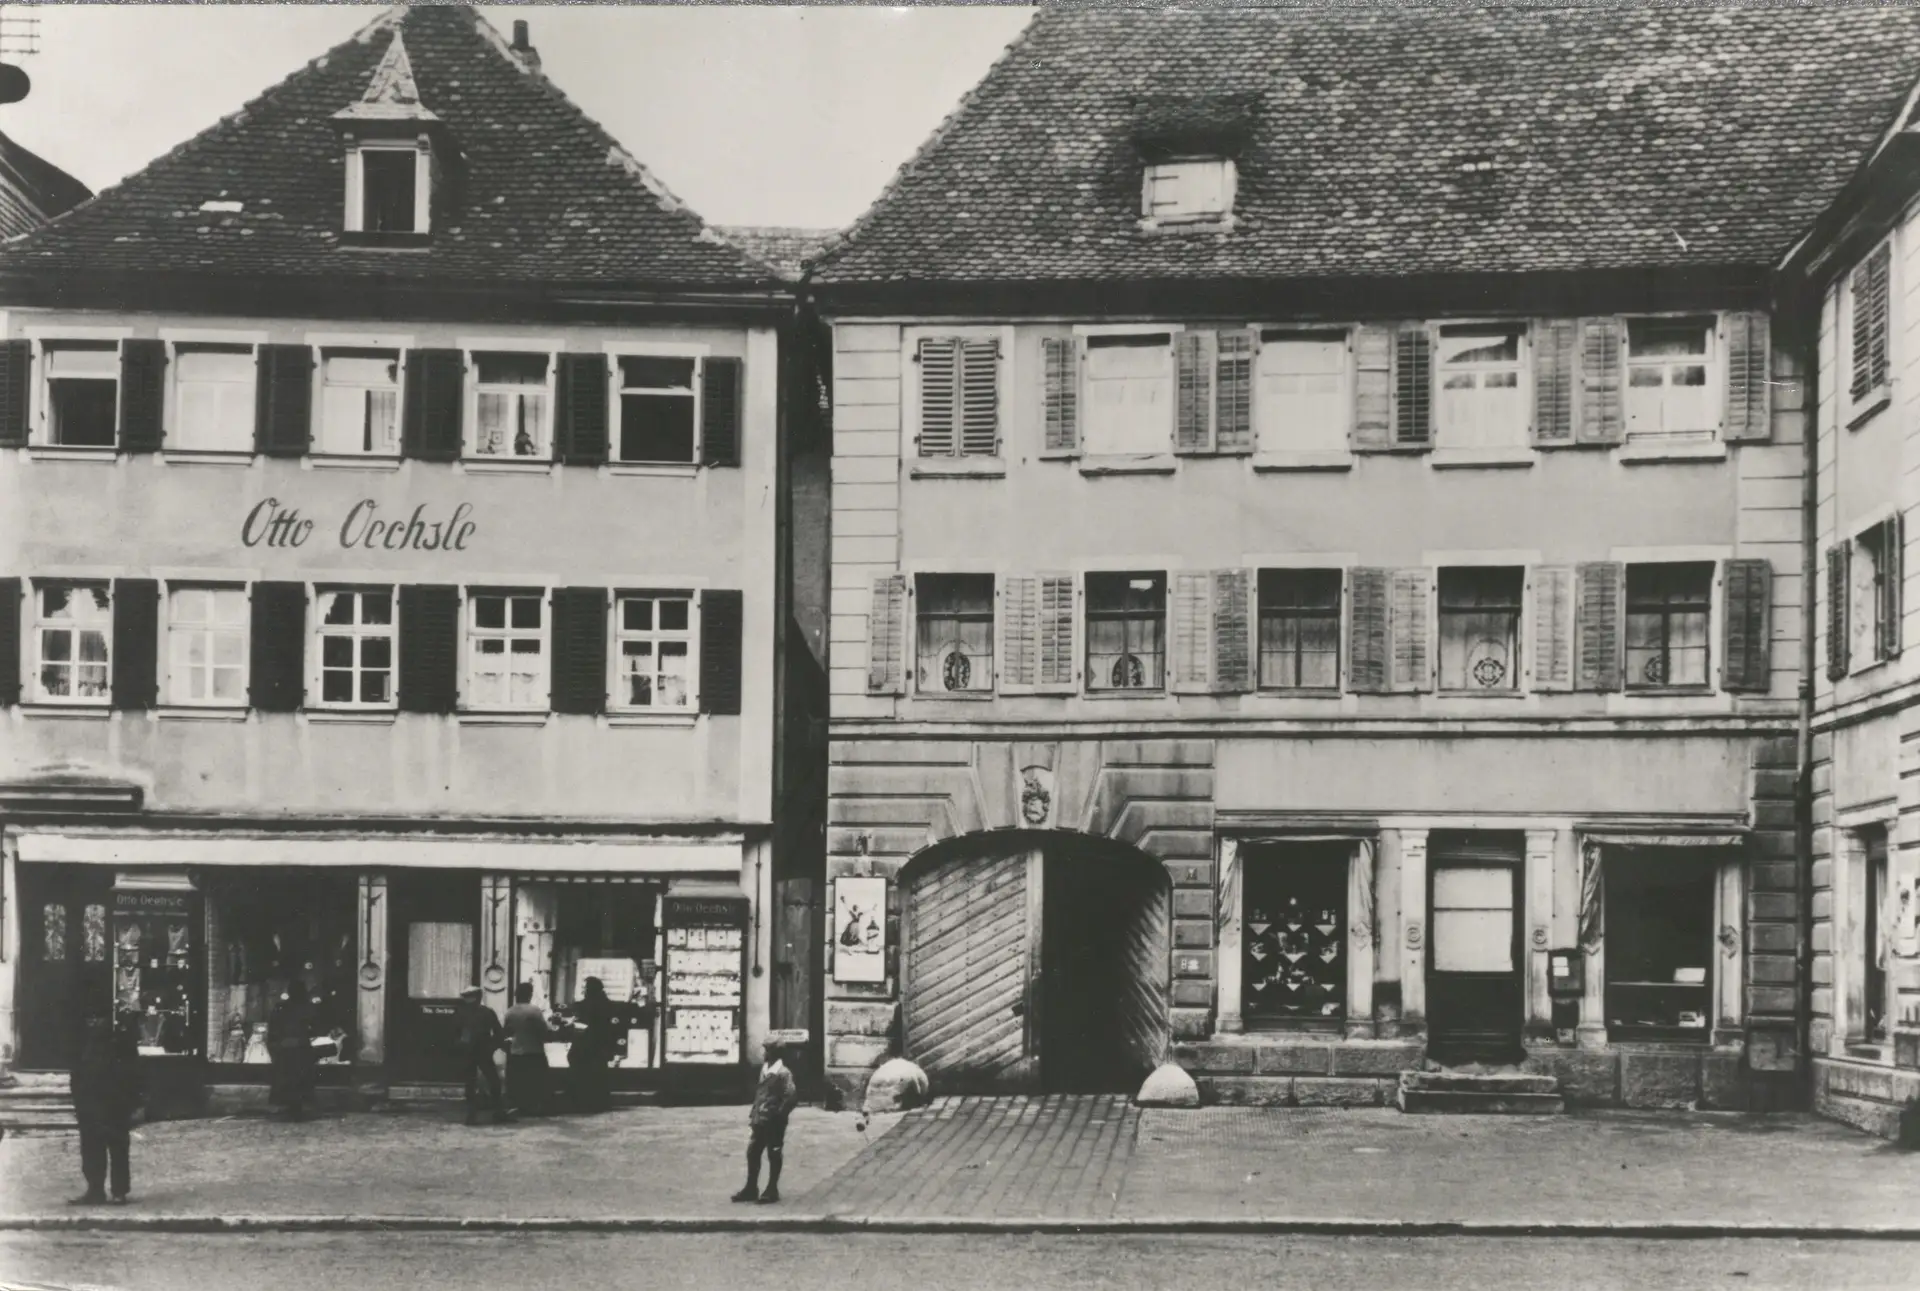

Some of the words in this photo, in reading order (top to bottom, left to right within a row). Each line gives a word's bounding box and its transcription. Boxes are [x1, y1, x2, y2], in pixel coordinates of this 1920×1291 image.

[241, 497, 314, 548] Otto
[339, 498, 476, 551] Oechsle
[116, 893, 137, 905] Otto
